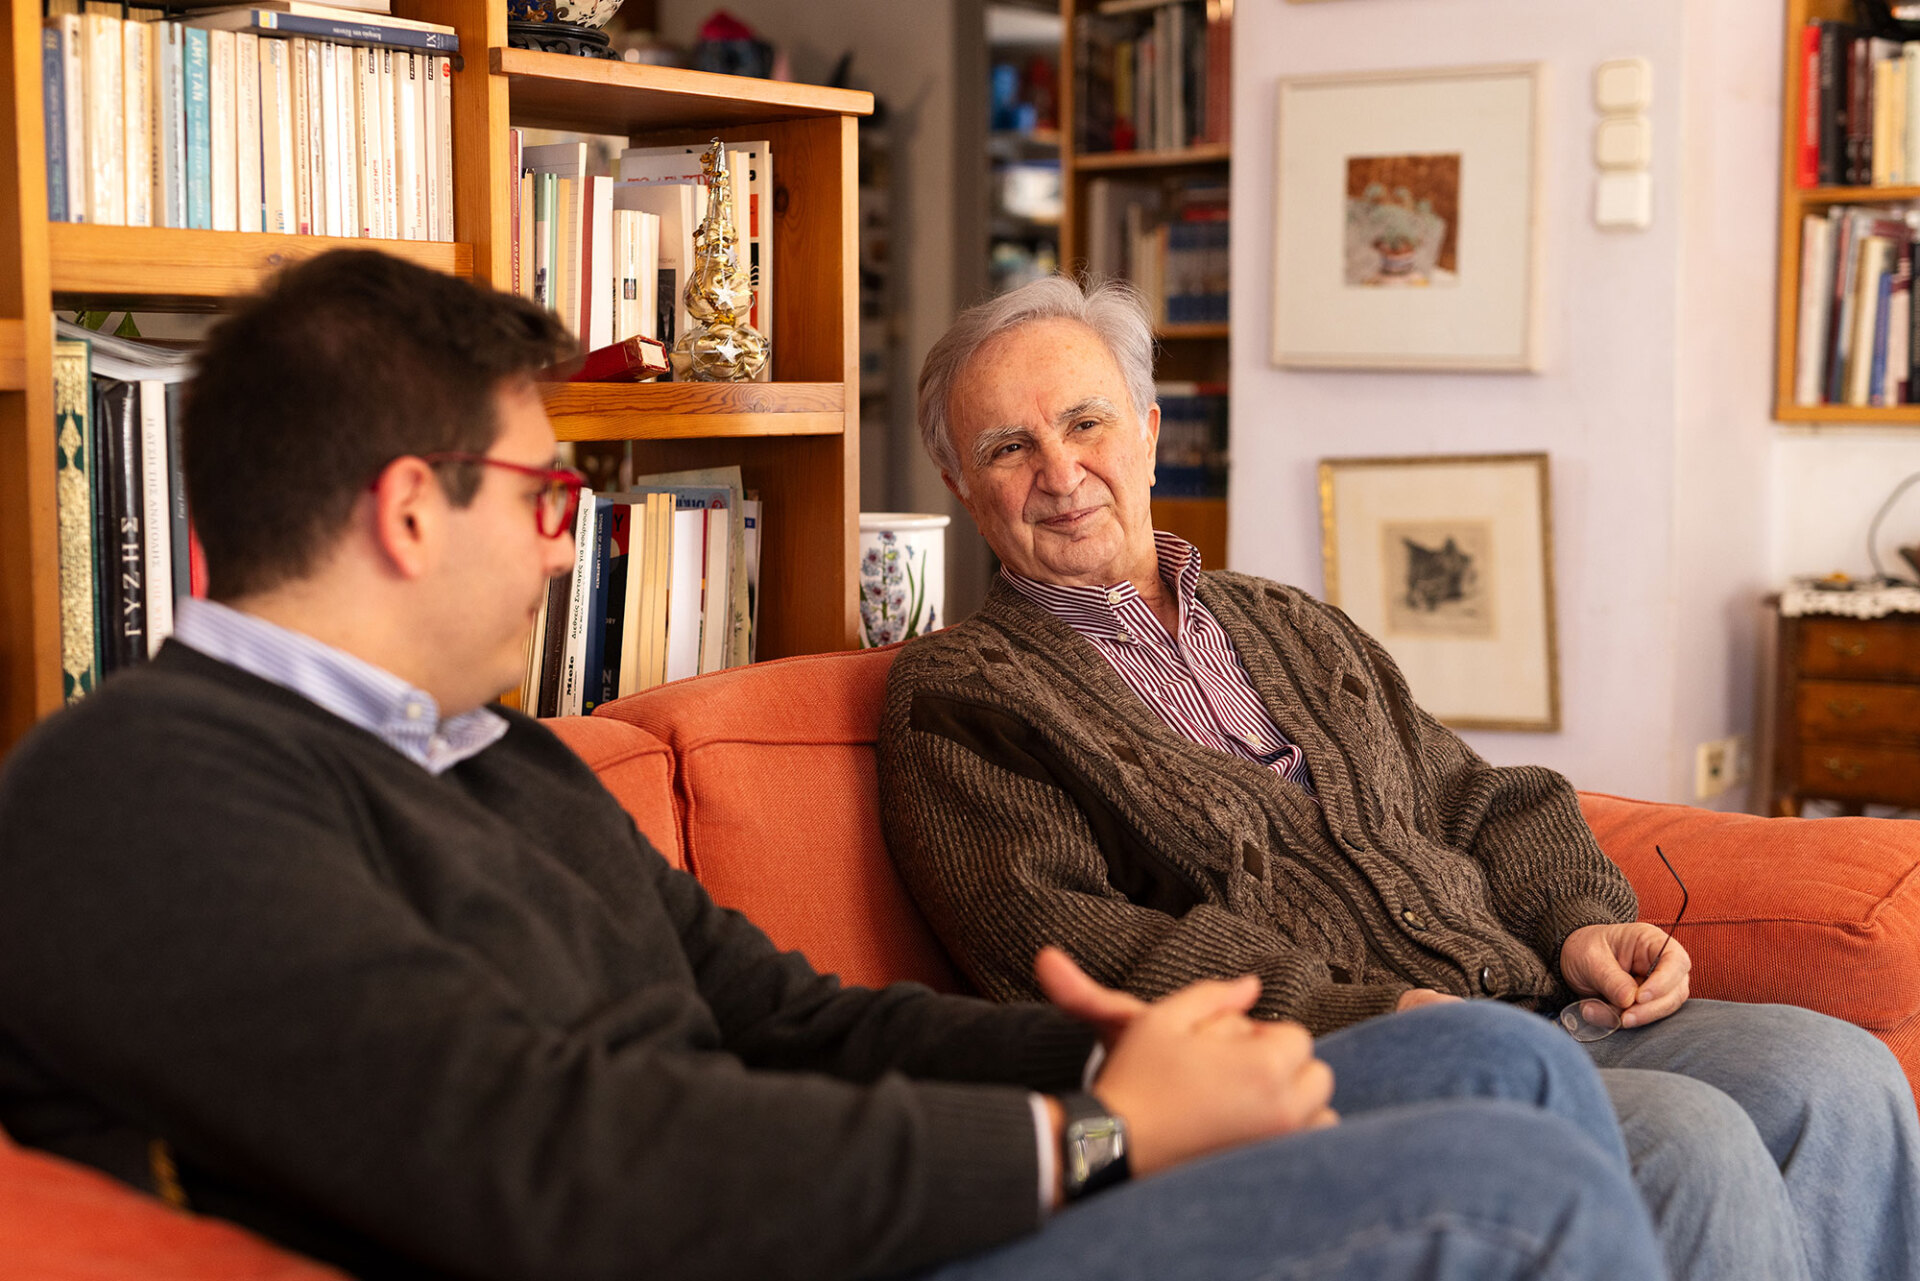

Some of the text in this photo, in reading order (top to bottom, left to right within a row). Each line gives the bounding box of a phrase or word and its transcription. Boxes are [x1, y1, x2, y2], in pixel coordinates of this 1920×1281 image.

[190, 36, 204, 66] AMY
[426, 33, 437, 48] IX
[191, 71, 206, 102] TAN
[120, 516, 143, 638] ΓΥΖΗΣ
[574, 564, 584, 603] Συνταγές
[570, 604, 580, 640] Διεθνείς
[566, 655, 575, 696] Miele
